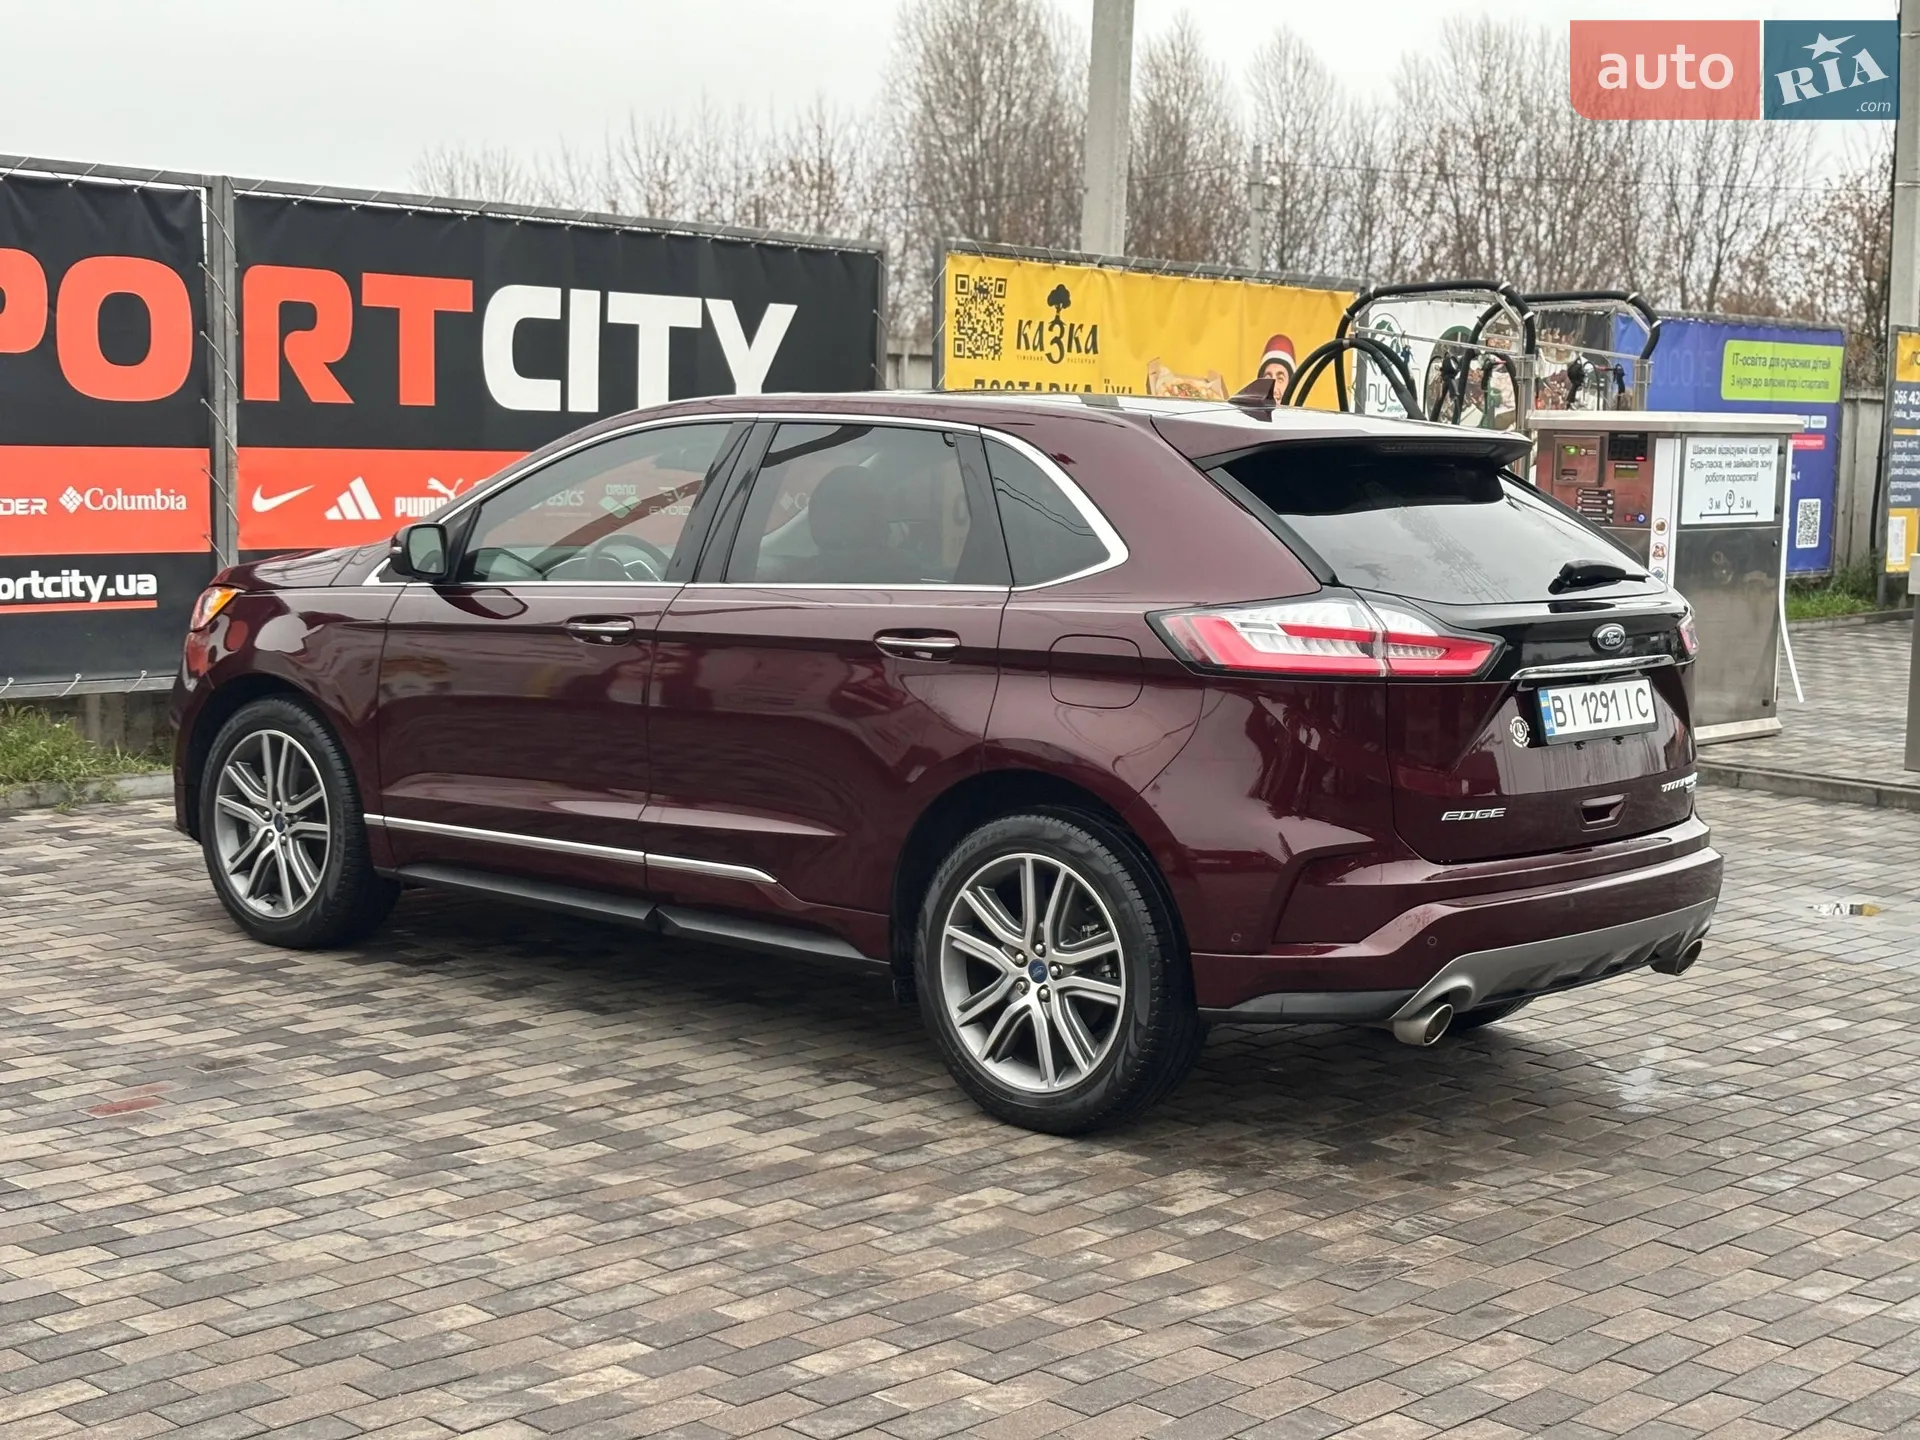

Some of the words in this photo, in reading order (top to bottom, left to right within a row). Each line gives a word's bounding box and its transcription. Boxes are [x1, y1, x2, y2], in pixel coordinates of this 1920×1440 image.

[84, 487, 188, 511] Columbia
[0, 569, 158, 603] ortcity.ua
[1581, 689, 1621, 724] 1291
[1441, 807, 1507, 821] EDGE
